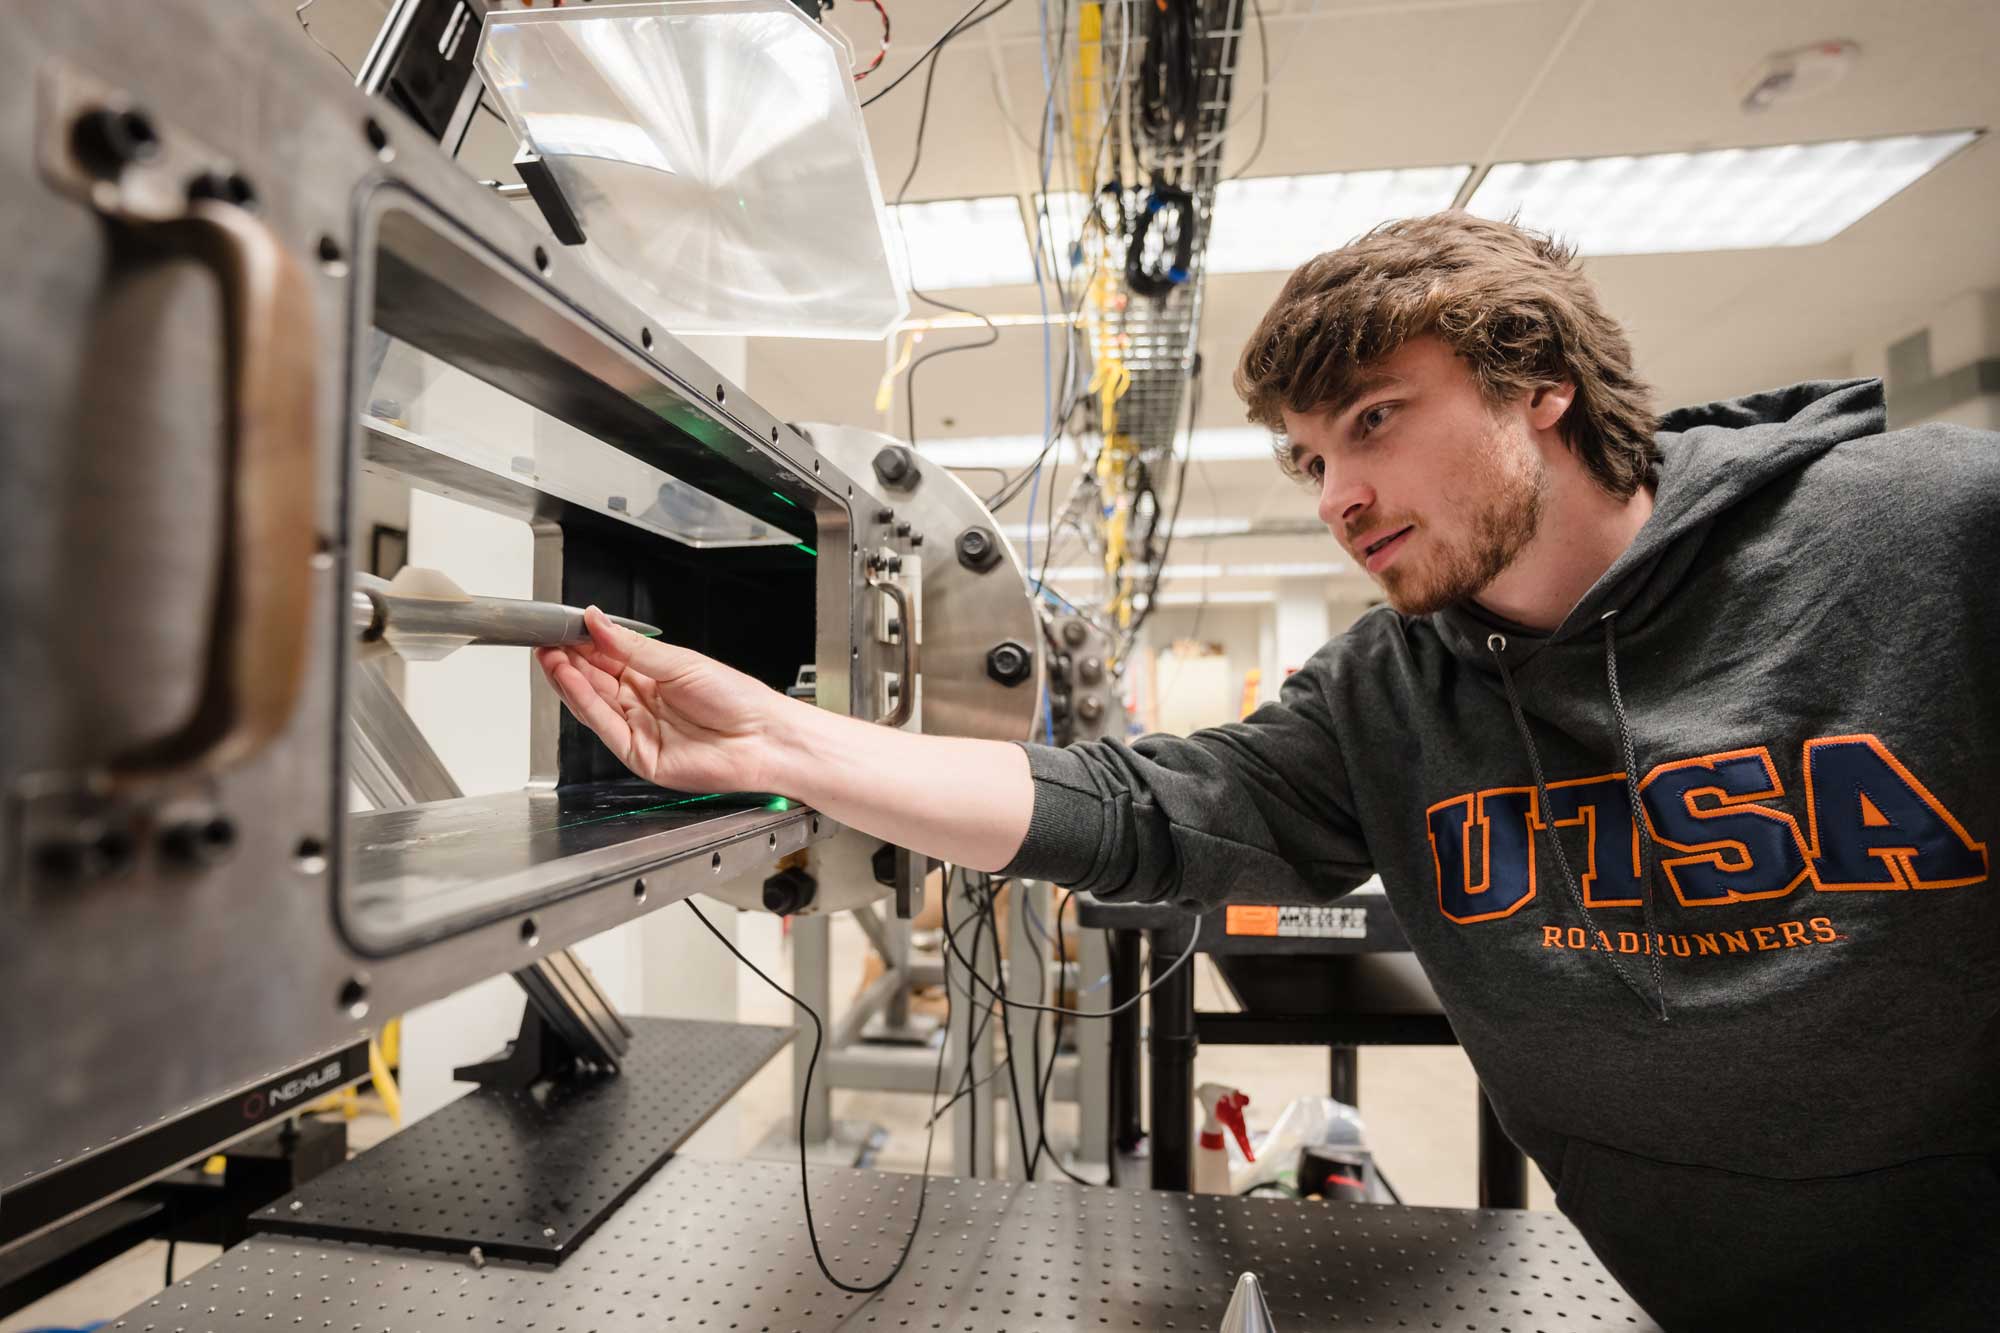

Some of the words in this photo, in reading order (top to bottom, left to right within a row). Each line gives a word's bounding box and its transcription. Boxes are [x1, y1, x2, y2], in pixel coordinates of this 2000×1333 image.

[1426, 734, 1988, 925] UTSA
[1541, 917, 1837, 957] ROADRUNNERS
[269, 1061, 342, 1107] NEXUS
